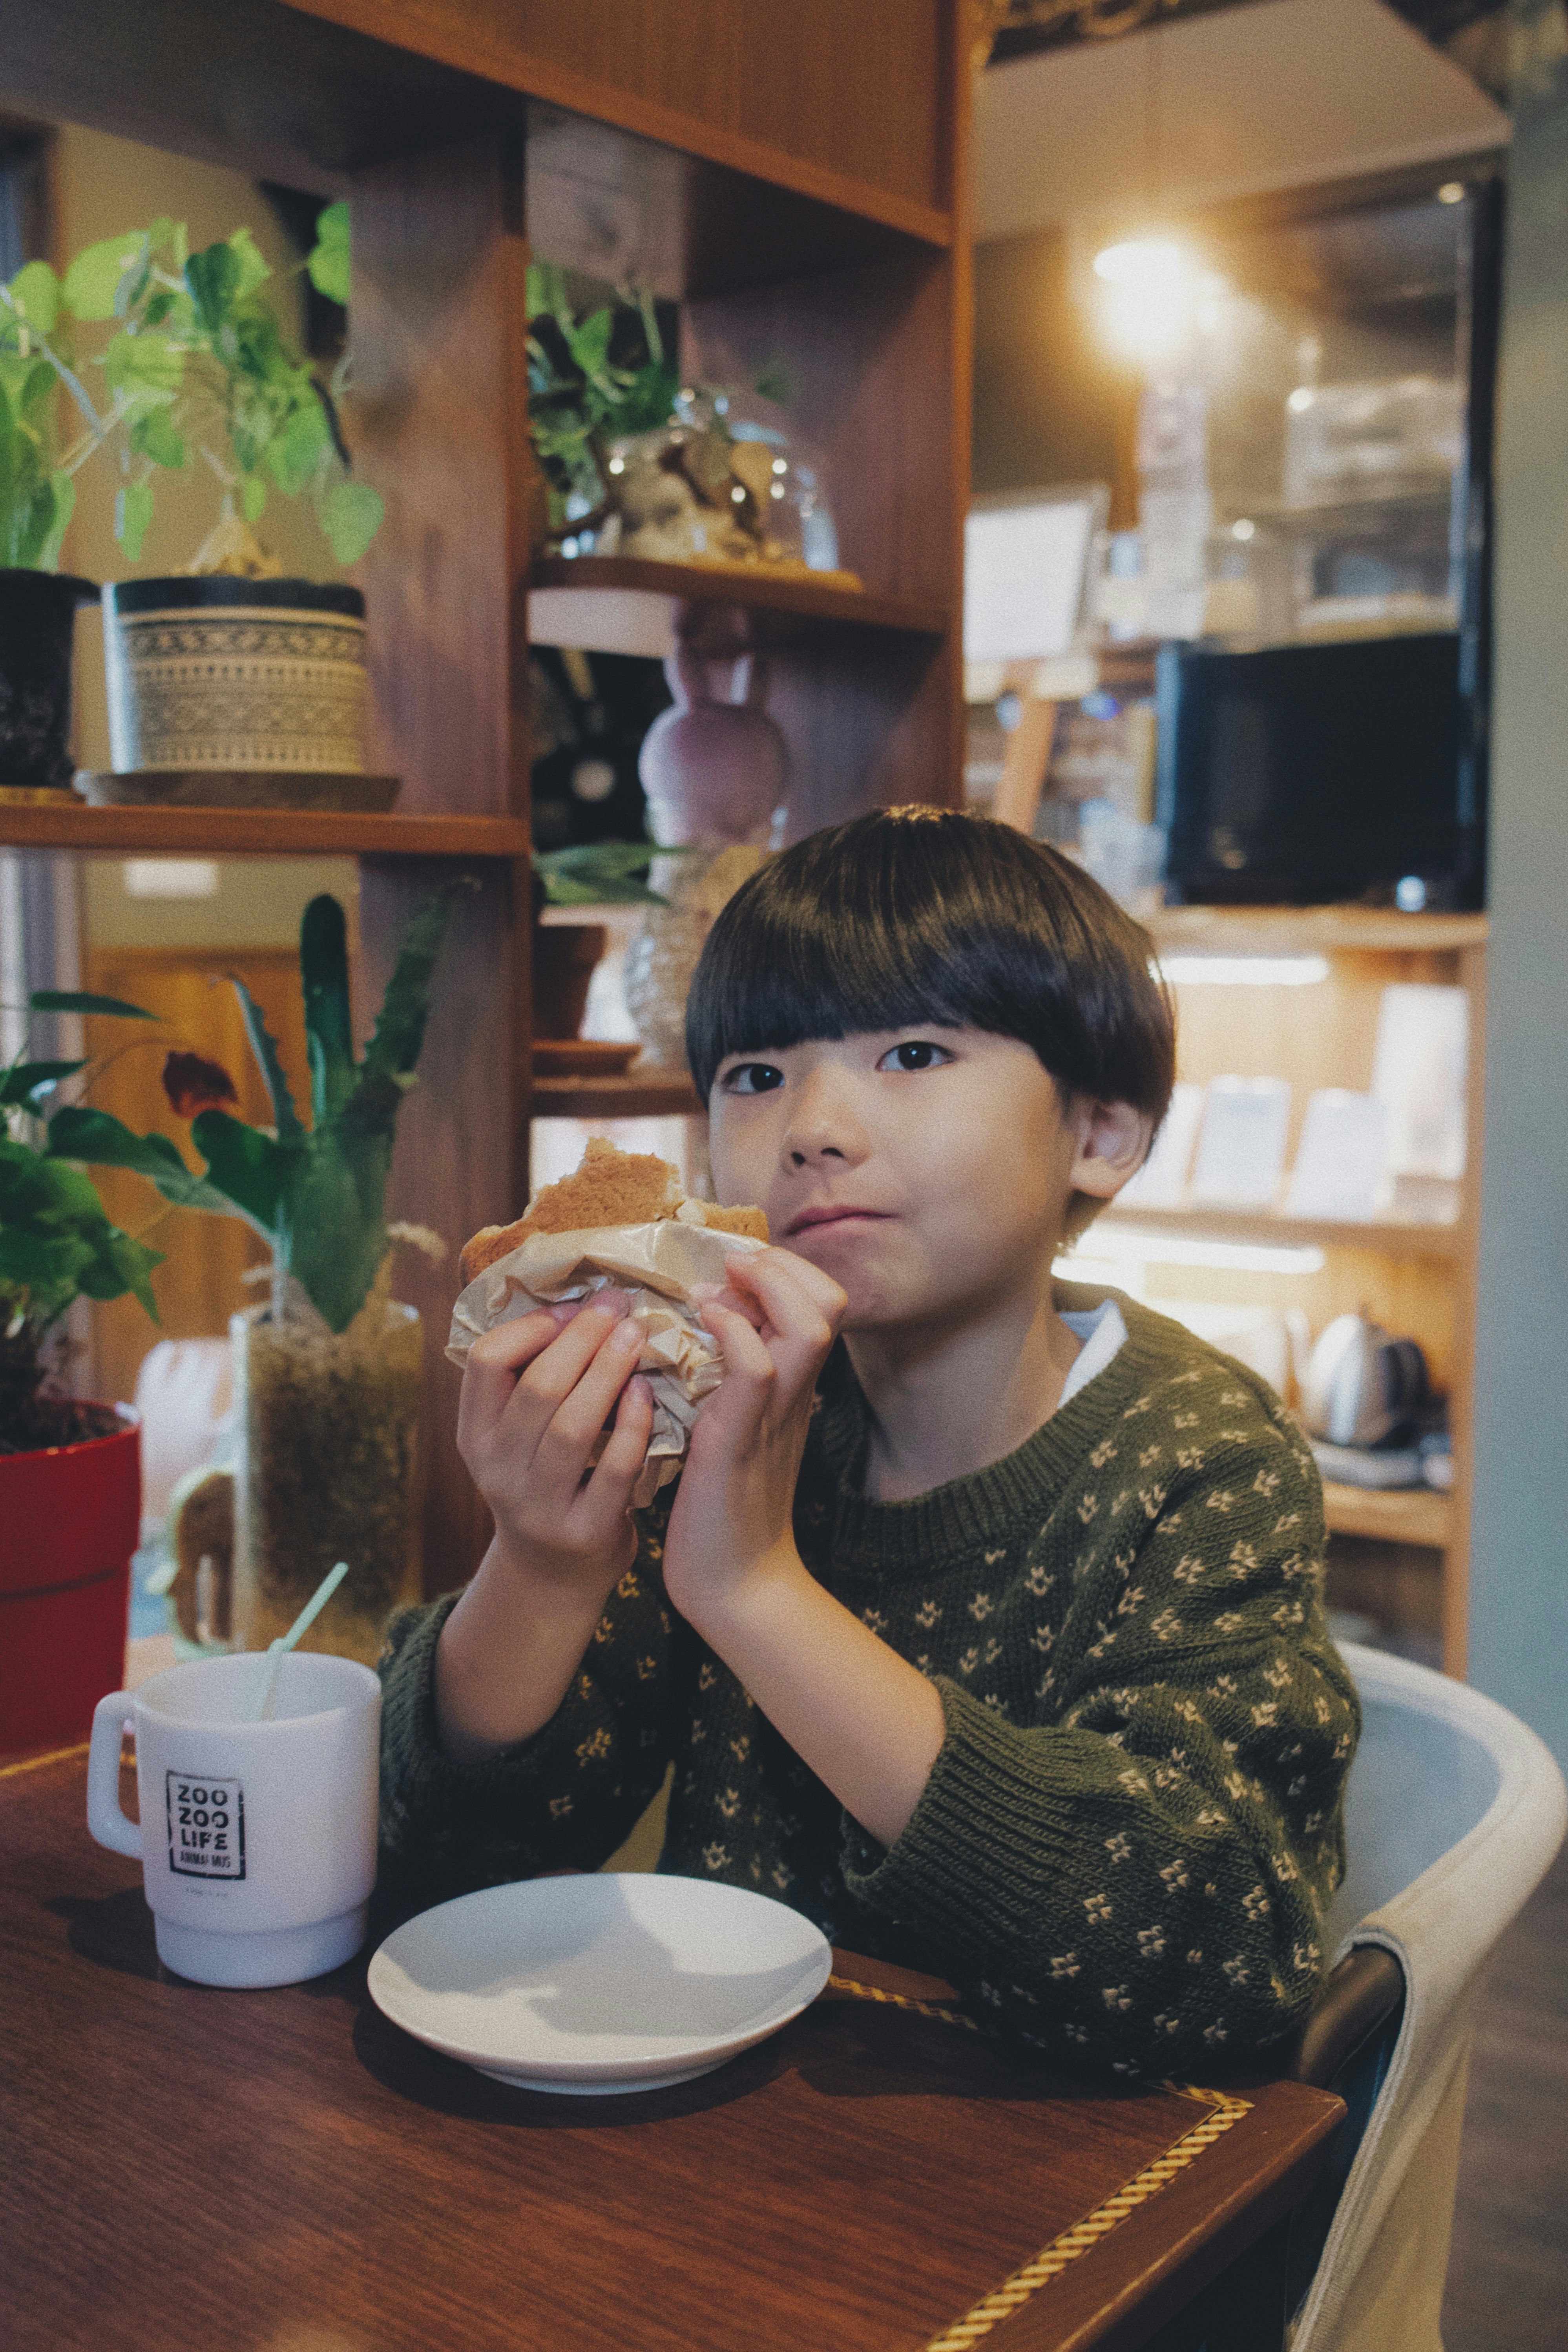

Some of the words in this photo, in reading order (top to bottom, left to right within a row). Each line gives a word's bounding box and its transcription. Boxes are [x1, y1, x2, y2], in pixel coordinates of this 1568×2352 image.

[178, 1785, 227, 1806] ZOO
[179, 1807, 228, 1828] ZOO
[181, 1828, 227, 1850] LIFE
